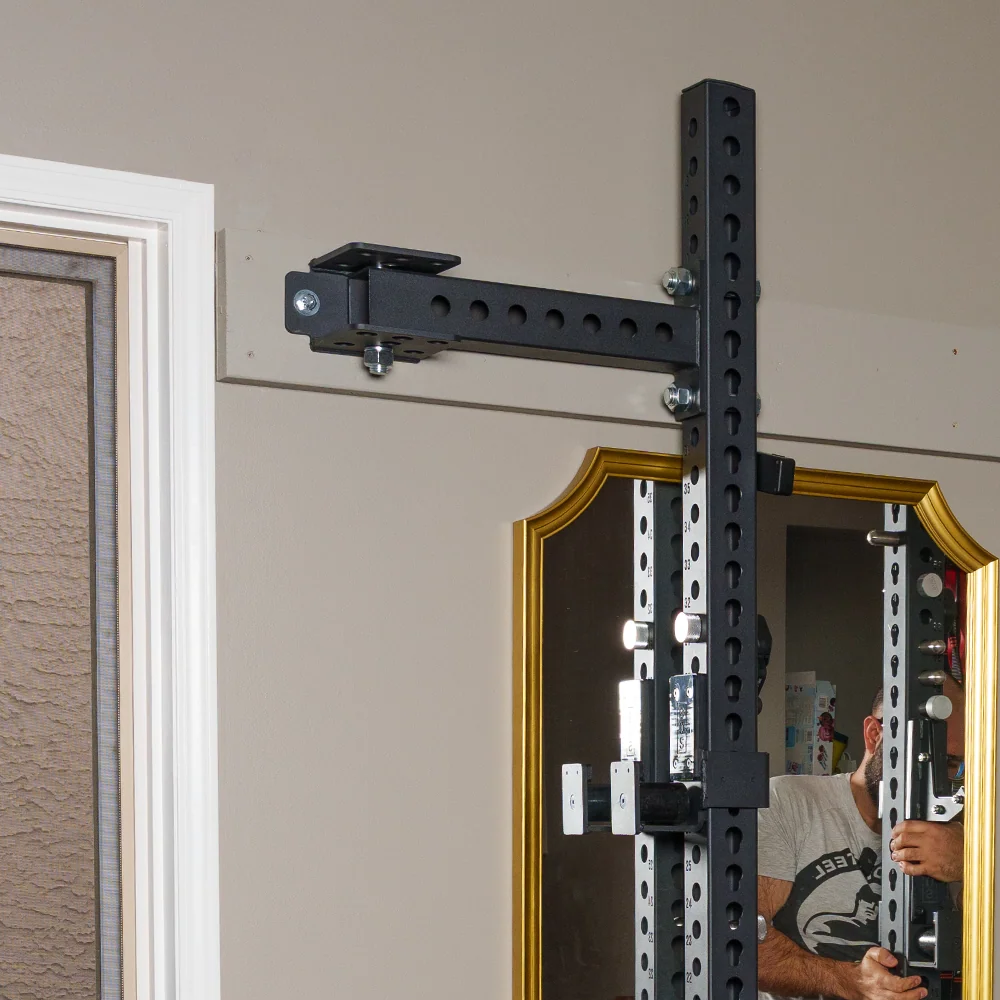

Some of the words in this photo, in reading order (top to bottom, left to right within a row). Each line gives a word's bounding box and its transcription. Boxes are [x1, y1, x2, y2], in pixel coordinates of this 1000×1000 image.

[684, 483, 691, 494] 35
[684, 522, 691, 533] 34
[684, 559, 691, 571] 33
[684, 597, 691, 609] 32
[686, 860, 692, 872] 25
[686, 898, 692, 909] 24
[686, 972, 693, 984] 22
